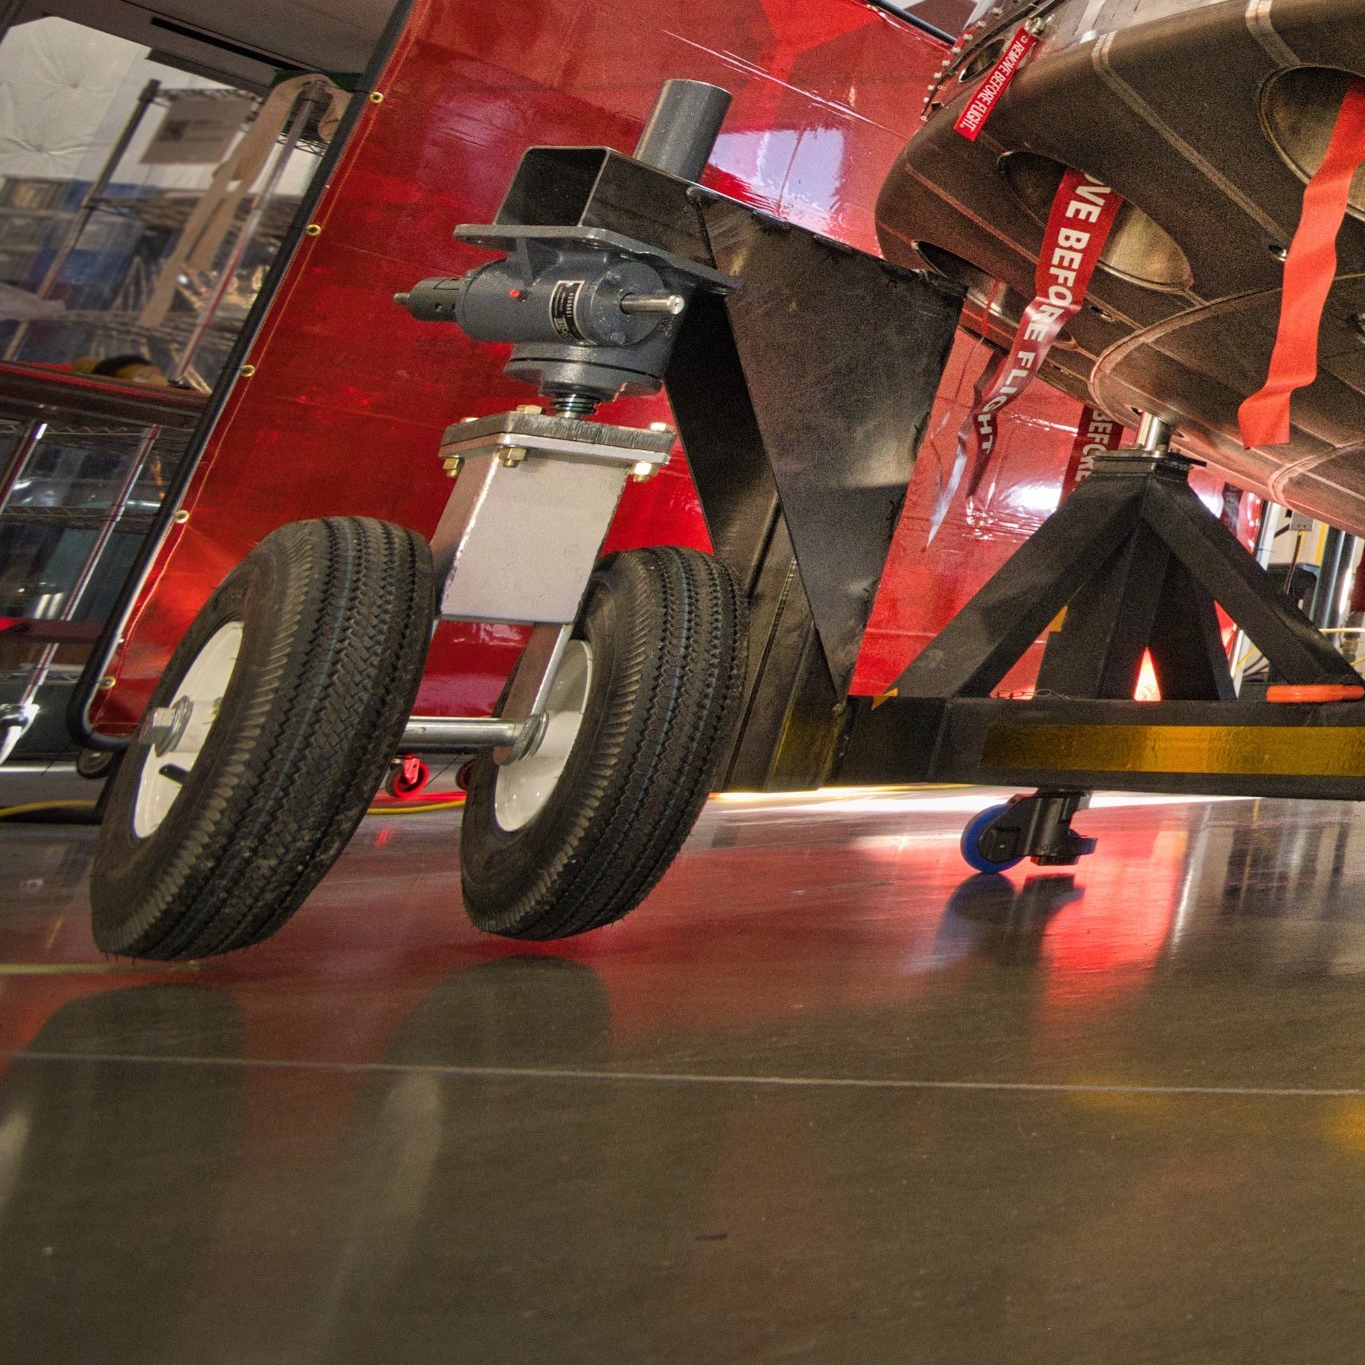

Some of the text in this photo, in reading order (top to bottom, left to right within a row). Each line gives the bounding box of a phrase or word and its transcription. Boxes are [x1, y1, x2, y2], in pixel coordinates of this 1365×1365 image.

[976, 71, 1006, 105] BEFORE
[999, 40, 1024, 76] REMOVE
[1024, 227, 1090, 342] BEFORE
[978, 351, 1036, 454] FLIGHT
